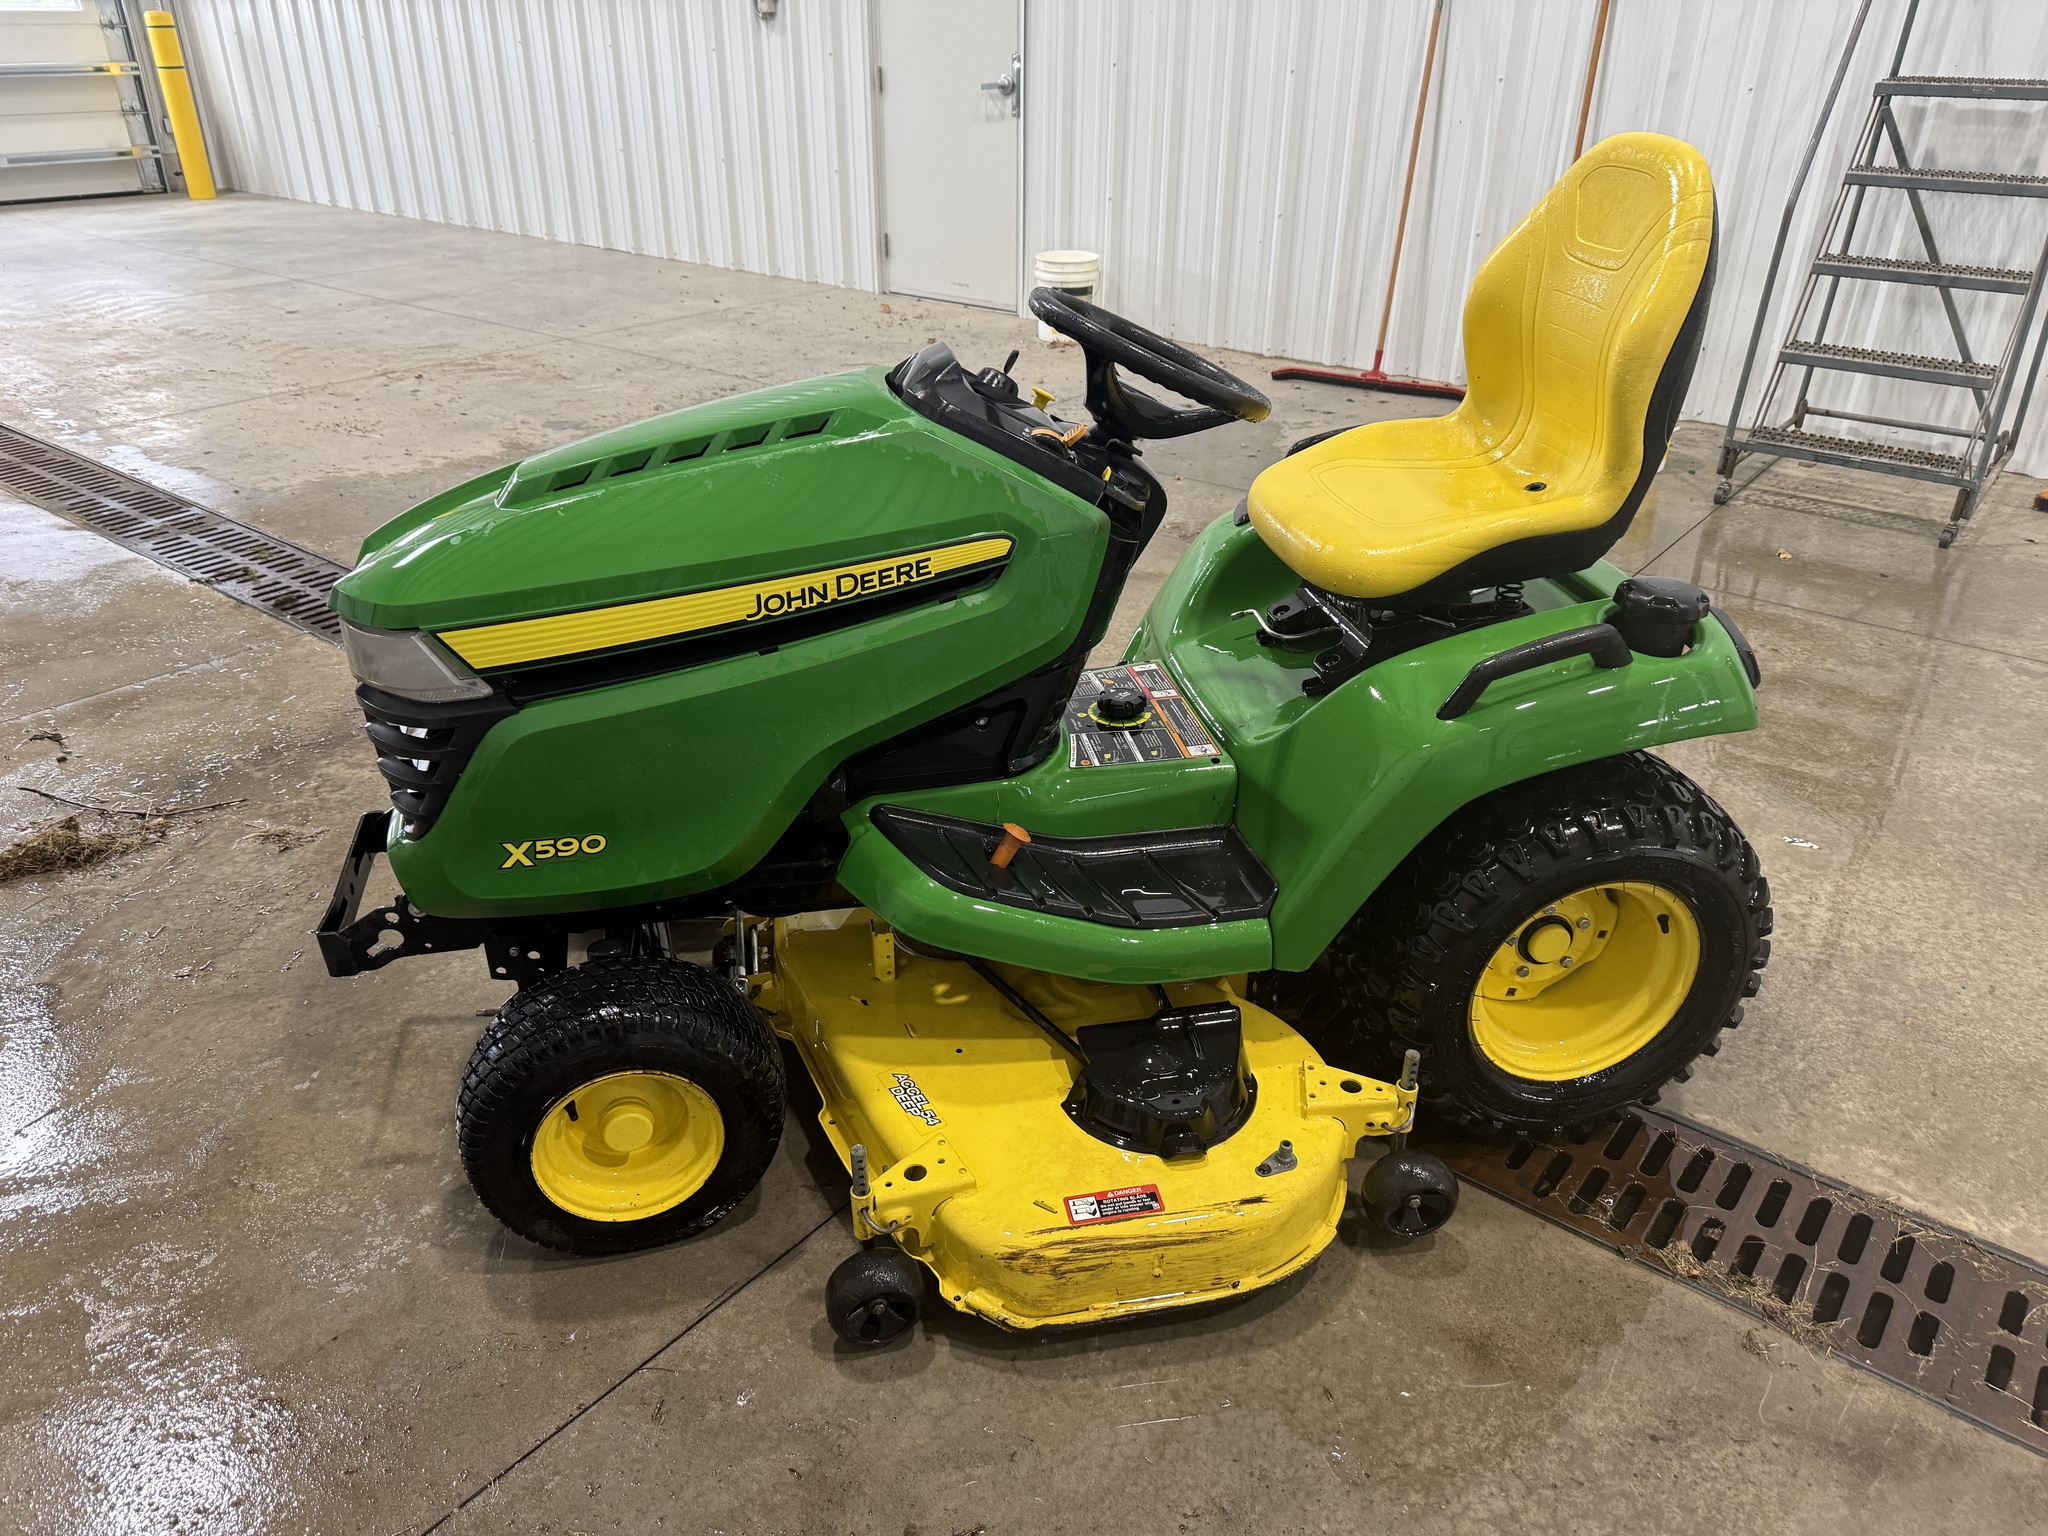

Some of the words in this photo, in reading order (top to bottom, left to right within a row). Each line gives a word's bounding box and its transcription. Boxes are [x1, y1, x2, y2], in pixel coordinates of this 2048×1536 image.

[745, 582, 829, 620] JOHN
[835, 556, 932, 599] DEERE
[498, 833, 608, 870] X590
[888, 1086, 921, 1117] DEEP
[892, 1073, 930, 1111] ACCEL
[920, 1109, 942, 1126] 54
[1103, 1196, 1129, 1204] ROTATING
[1114, 1187, 1142, 1196] DANGER
